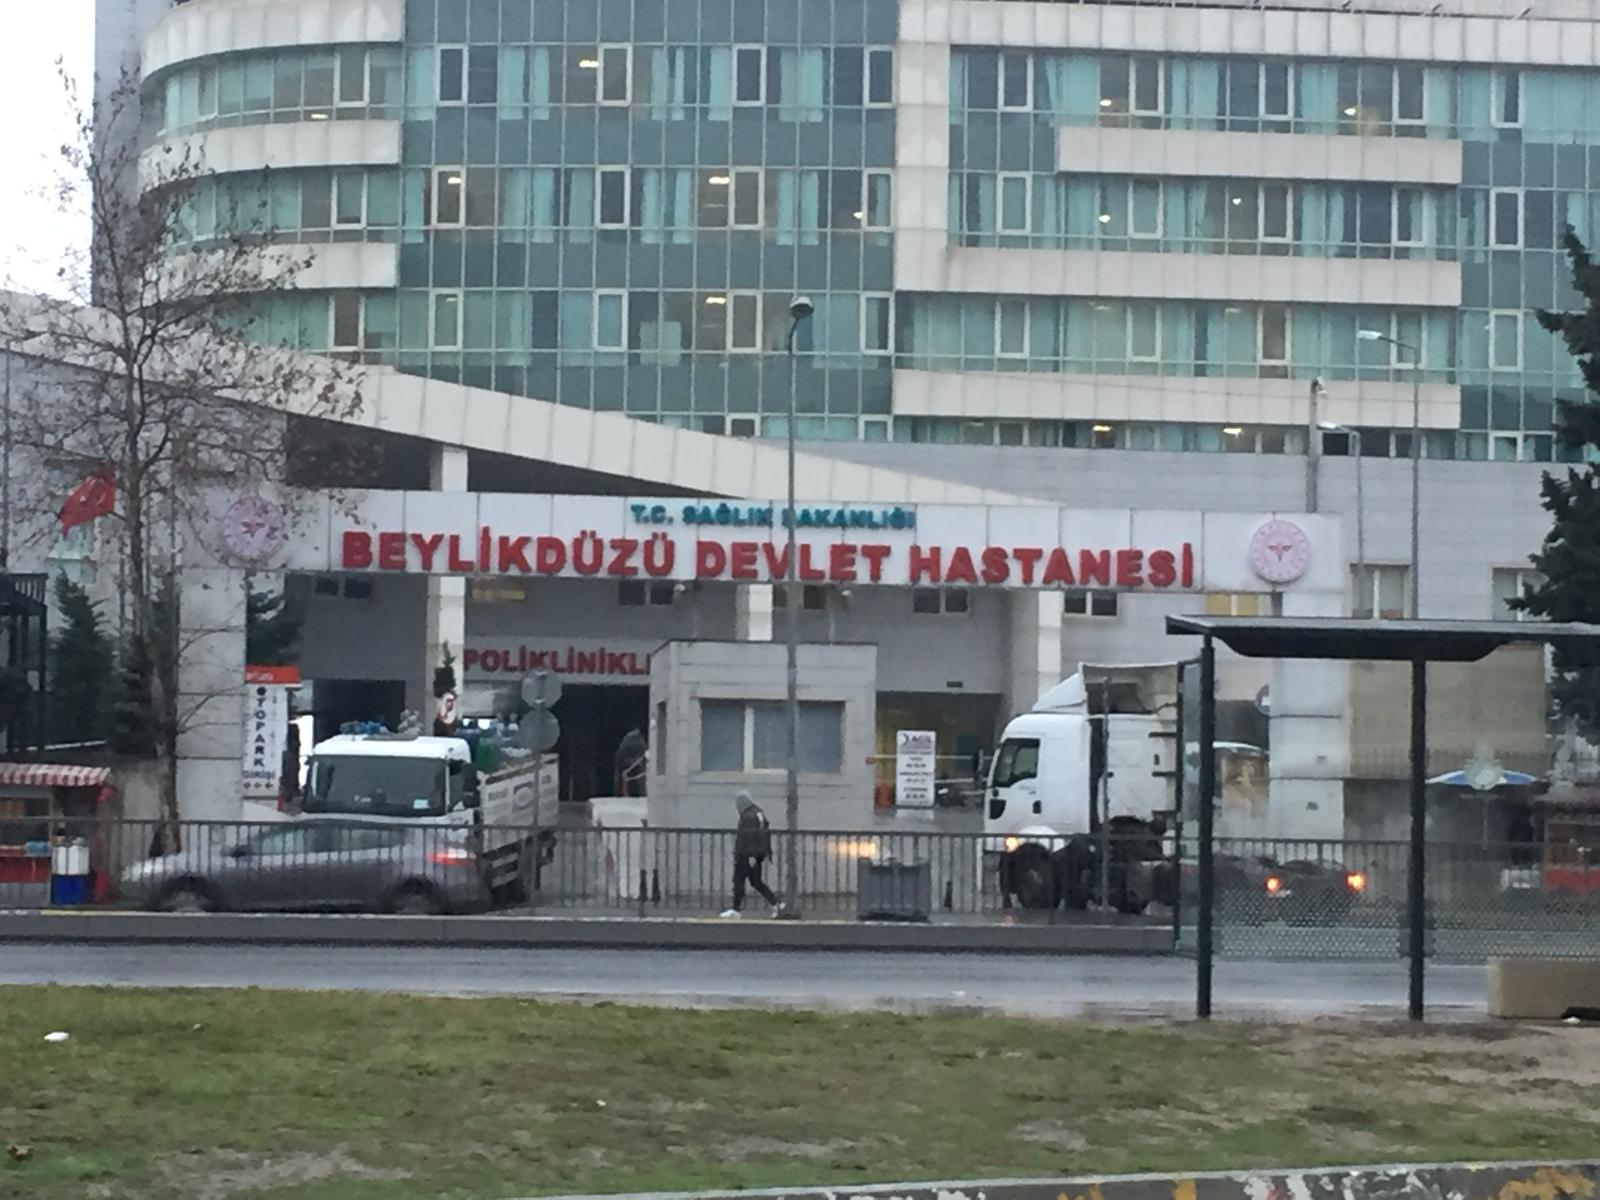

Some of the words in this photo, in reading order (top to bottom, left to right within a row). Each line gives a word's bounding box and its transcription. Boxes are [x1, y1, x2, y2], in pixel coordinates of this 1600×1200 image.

[630, 504, 674, 524] T.C.
[682, 503, 773, 527] SAĞLIK
[342, 526, 675, 577] BEYLİKDÜZÜ
[696, 540, 891, 582] DEVLET
[909, 542, 1194, 588] HASTANESİ
[463, 645, 651, 675] POLİKLİNİKL
